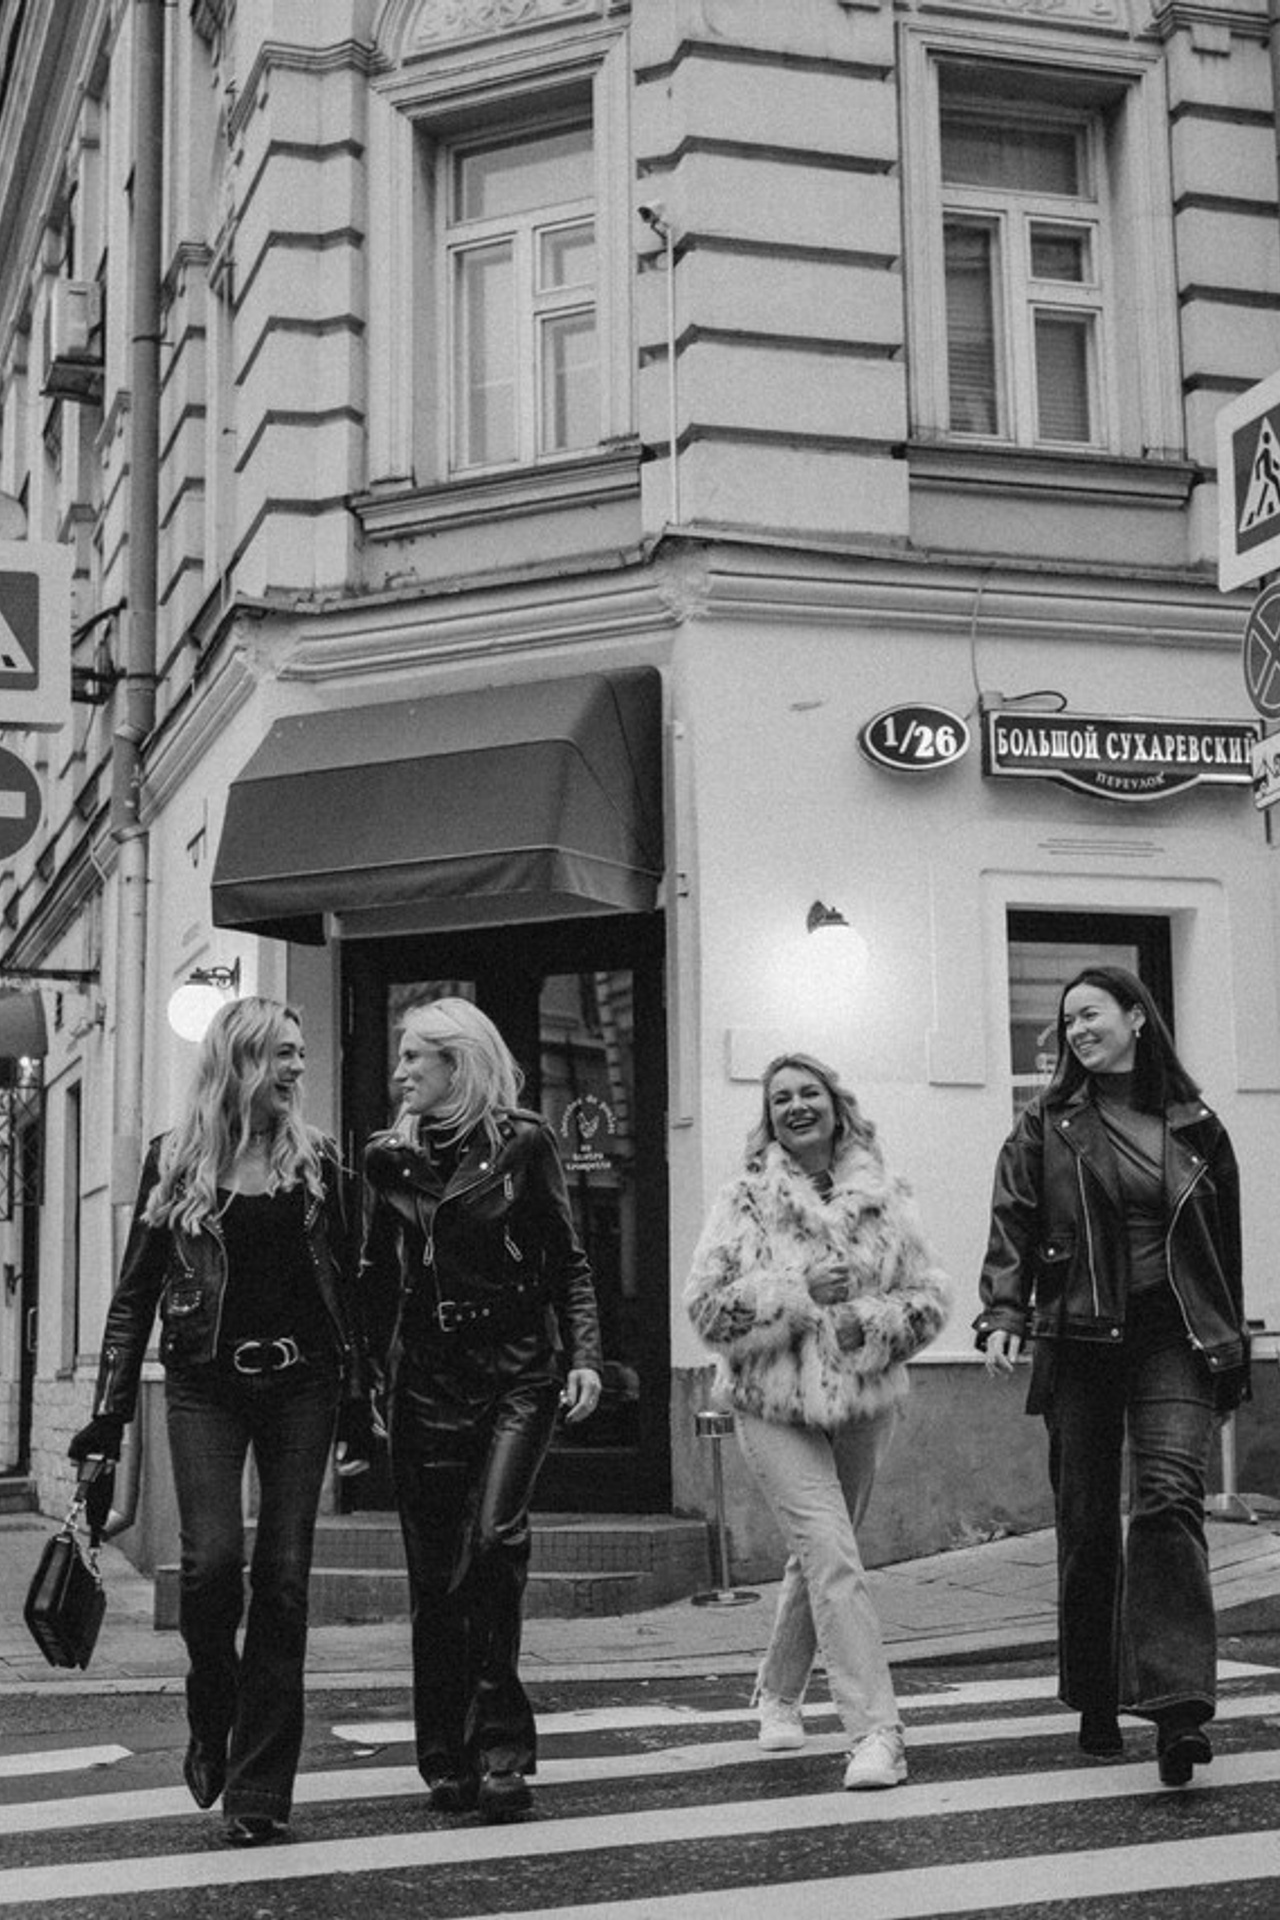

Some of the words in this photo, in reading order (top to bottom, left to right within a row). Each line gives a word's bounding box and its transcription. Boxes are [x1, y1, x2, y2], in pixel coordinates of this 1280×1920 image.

[883, 716, 958, 757] 1/26
[997, 725, 1100, 759] БОЛЬШОЙ
[1096, 769, 1165, 790] ПЕРЕУЛОК
